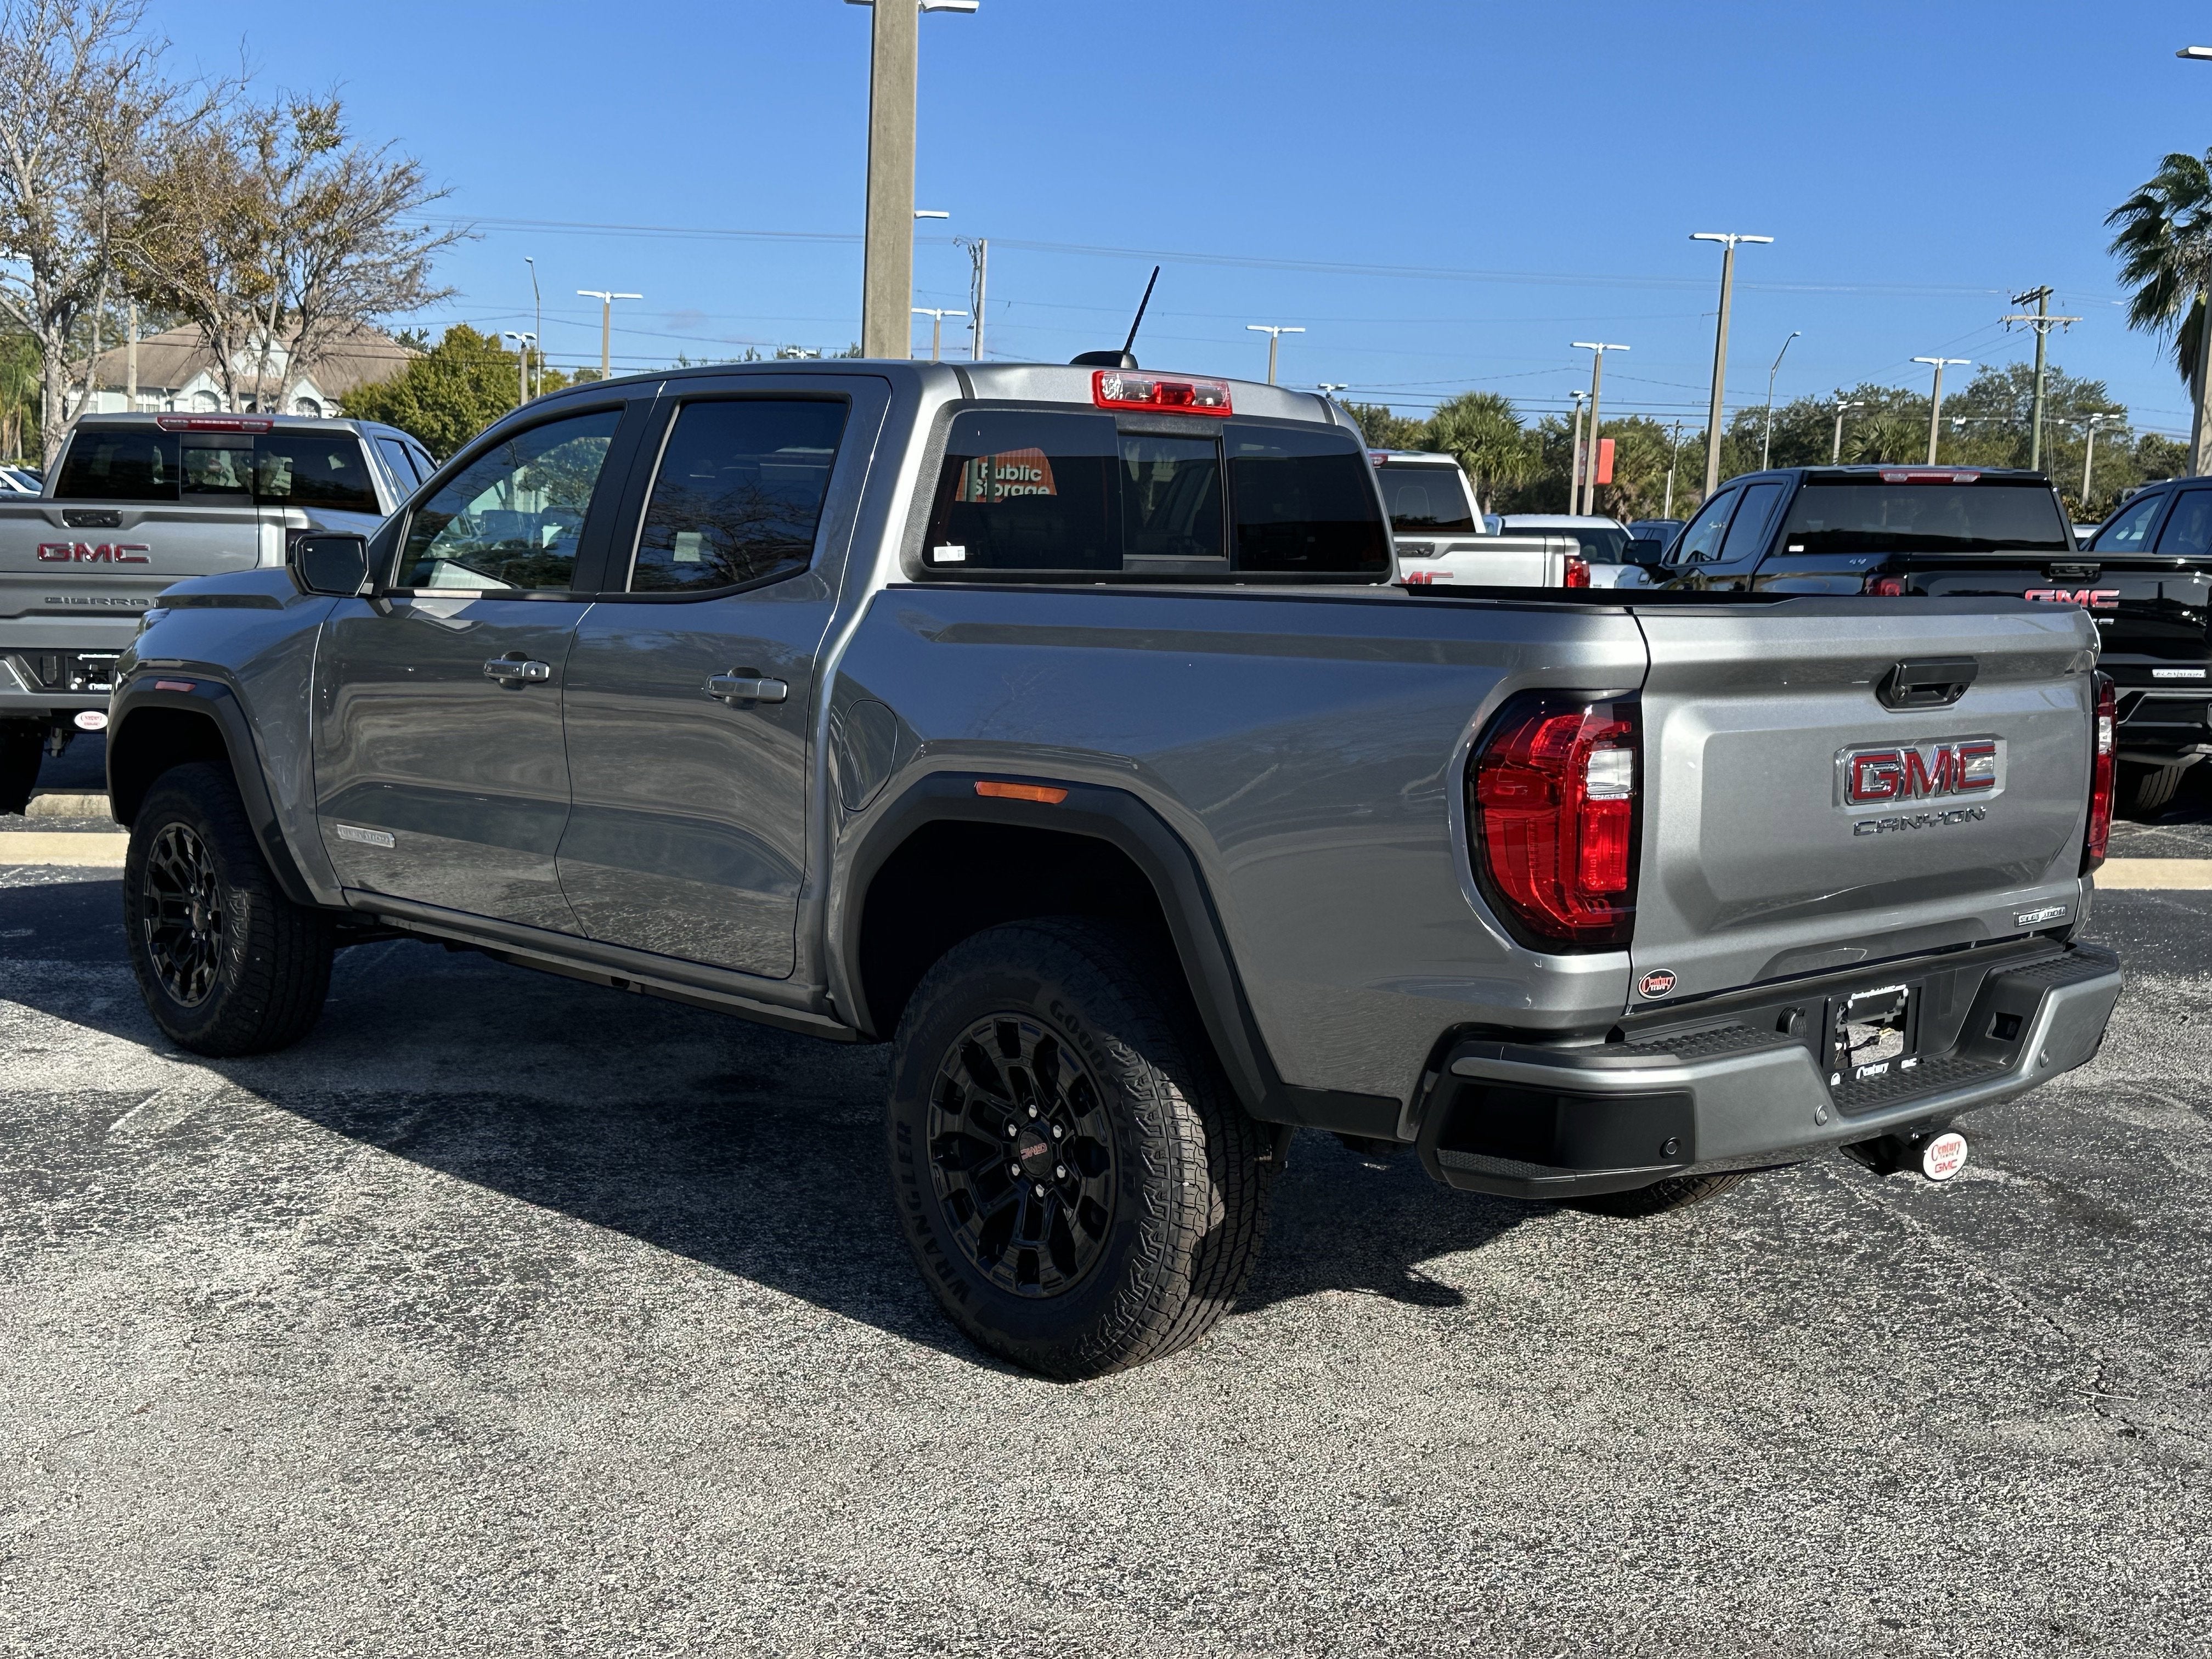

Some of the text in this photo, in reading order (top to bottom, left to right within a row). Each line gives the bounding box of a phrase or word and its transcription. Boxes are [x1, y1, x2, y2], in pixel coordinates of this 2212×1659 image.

[37, 542, 151, 563] GMC
[2024, 589, 2119, 608] GMC
[1845, 740, 1996, 805] GMC
[1853, 806, 1987, 836] CANYON
[1020, 1143, 1047, 1160] GMC
[1931, 1141, 1961, 1161] Century
[1935, 1159, 1957, 1173] GMC
[897, 1121, 972, 1303] WRANGLER
